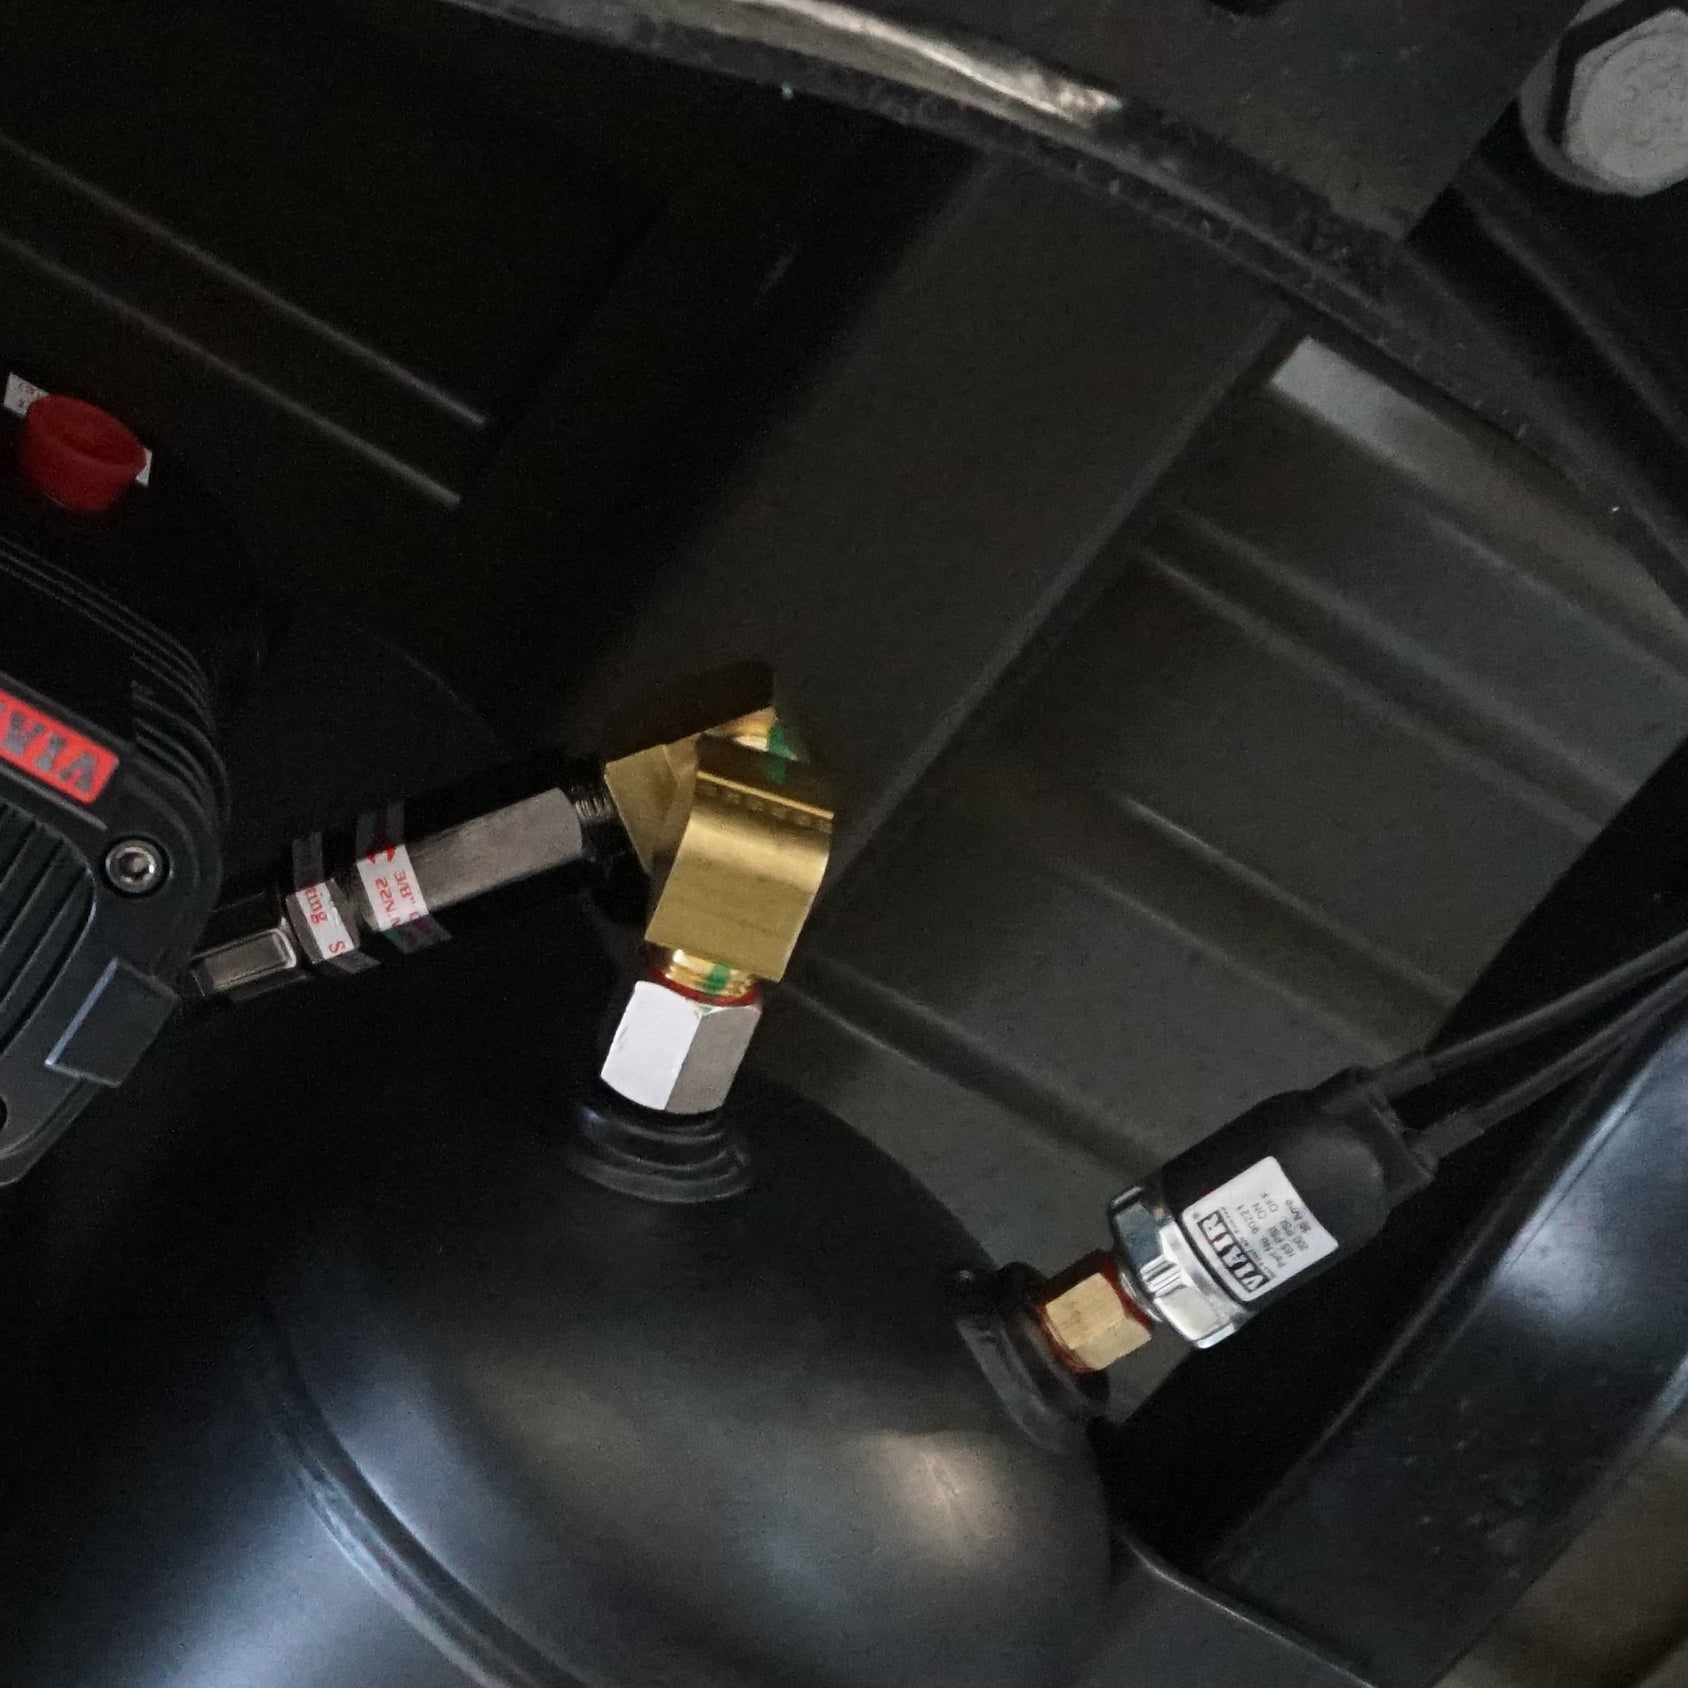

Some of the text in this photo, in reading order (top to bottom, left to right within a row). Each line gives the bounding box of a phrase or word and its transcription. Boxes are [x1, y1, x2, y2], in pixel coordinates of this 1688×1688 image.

[1250, 1201, 1267, 1219] ON
[1259, 1190, 1279, 1213] OFF
[1198, 1212, 1267, 1293] VIAIR
